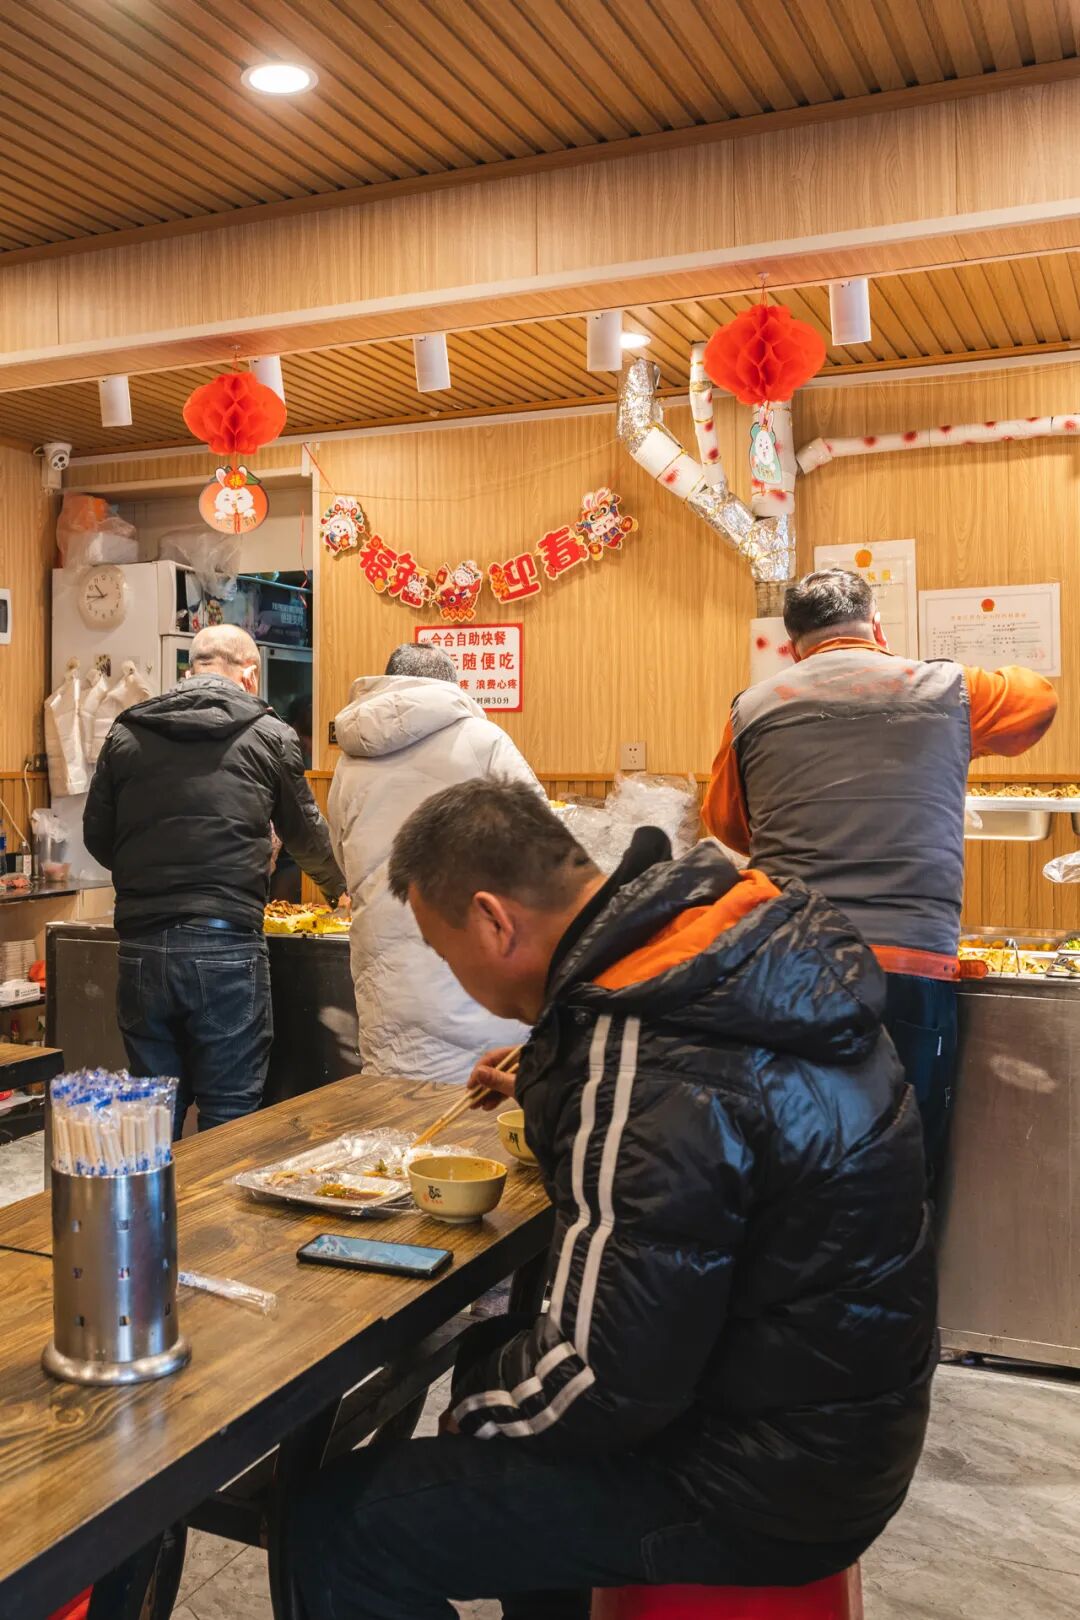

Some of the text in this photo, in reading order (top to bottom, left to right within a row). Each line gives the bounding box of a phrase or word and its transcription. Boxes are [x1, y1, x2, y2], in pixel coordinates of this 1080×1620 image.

[488, 525, 590, 603] 迎春
[431, 631, 506, 647] 合合自助快餐
[476, 679, 518, 690] 浪费心疼
[472, 696, 509, 705] 时间30分
